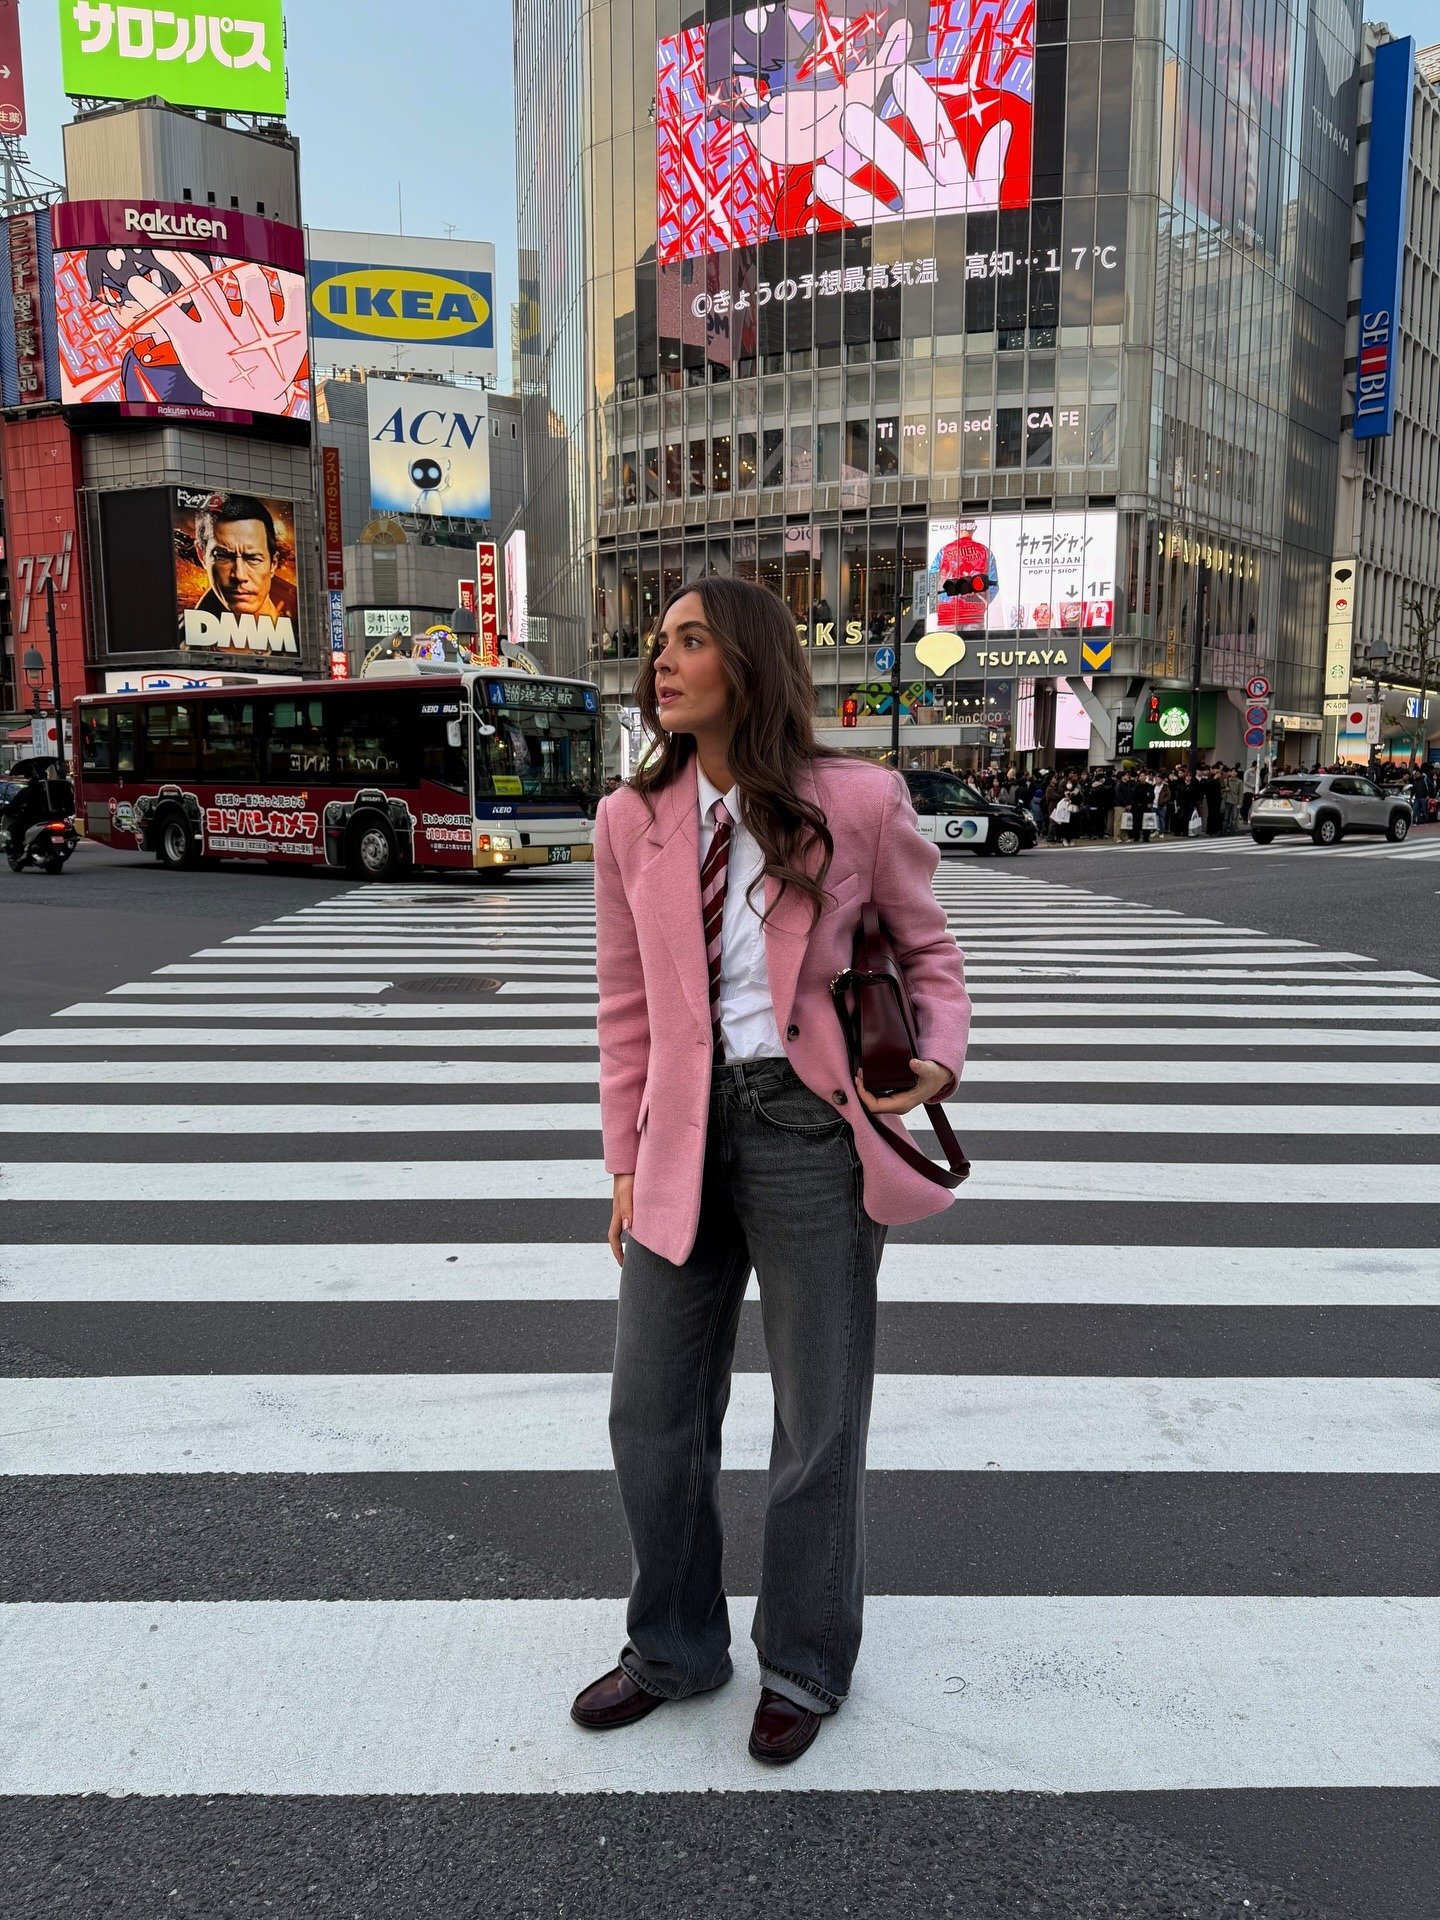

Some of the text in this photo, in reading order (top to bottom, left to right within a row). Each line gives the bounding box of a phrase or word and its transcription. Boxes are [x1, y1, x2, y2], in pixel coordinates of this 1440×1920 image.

[73, 0, 272, 72] サロンパス
[1311, 105, 1350, 156] TSUTAYA
[124, 208, 228, 240] Rakuten
[9, 219, 37, 393] 三千里薬品
[328, 284, 478, 323] IKEA
[1356, 310, 1390, 417] SEIBU
[157, 405, 215, 418] Rakuten Vision
[371, 406, 485, 449] ACN
[937, 415, 991, 434] based
[1027, 410, 1079, 429] CAFE
[326, 452, 339, 543] クスリのことなら
[1016, 532, 1094, 556] キャラジャン
[1022, 556, 1081, 566] CHARAJAN
[16, 530, 73, 633] クスリ
[480, 553, 496, 625] カラオケ
[1087, 581, 1111, 597] 1F
[184, 608, 298, 653] DMM
[976, 650, 1068, 667] TSUTAYA
[421, 704, 459, 714] KEIO BUS
[1118, 746, 1131, 754] B1F
[206, 807, 319, 839] ヨドバシカメラ
[491, 806, 513, 814] KEIO
[945, 820, 978, 839] GO
